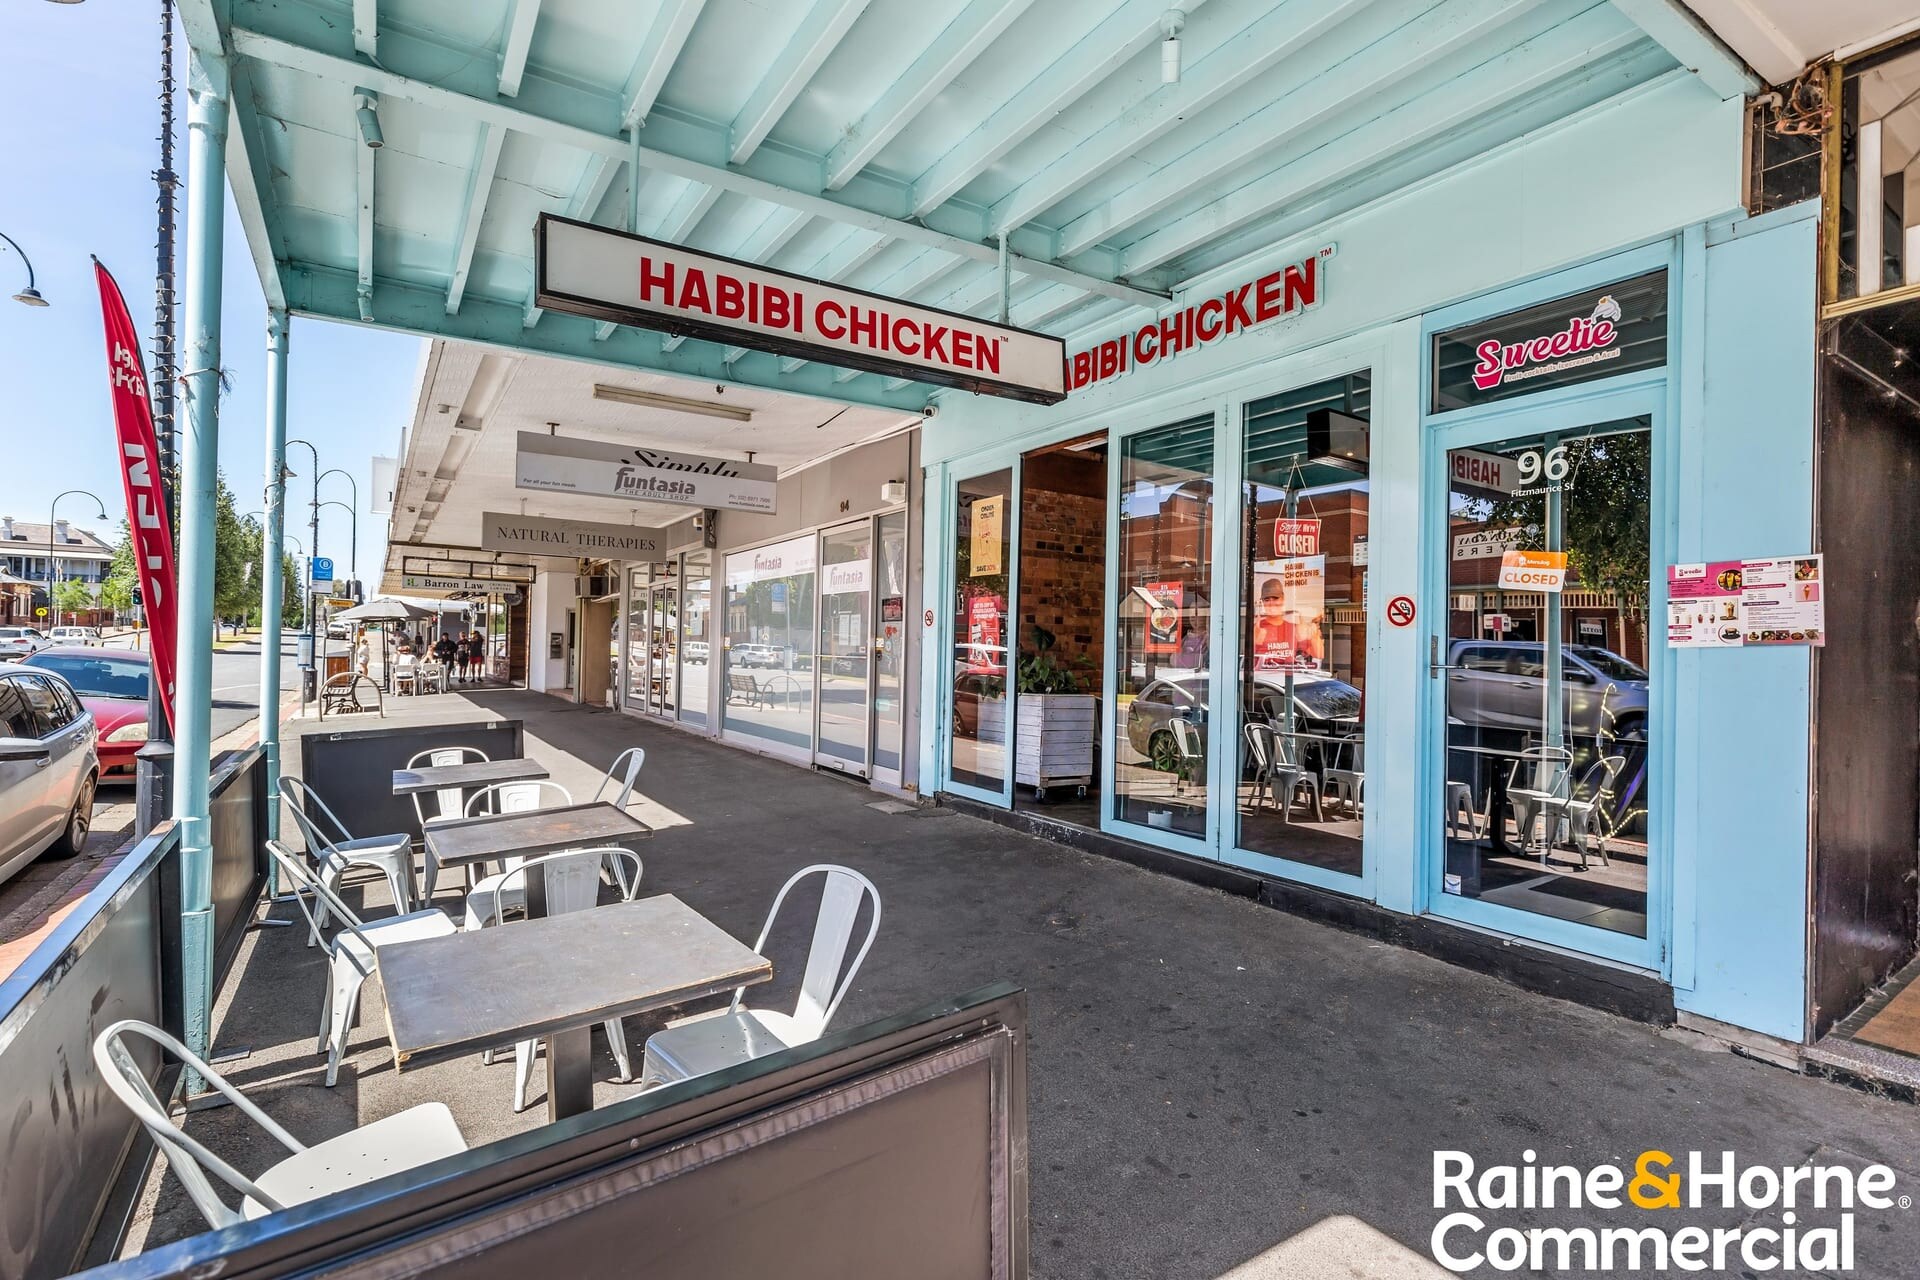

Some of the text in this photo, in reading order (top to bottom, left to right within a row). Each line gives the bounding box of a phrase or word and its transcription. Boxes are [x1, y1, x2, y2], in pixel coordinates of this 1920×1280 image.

[640, 256, 803, 333] HABIBI
[815, 300, 1001, 374] CHICKEN
[1065, 335, 1127, 392] BIBI
[1134, 256, 1316, 365] CHICKEN
[1477, 317, 1618, 376] Sweetie
[1517, 446, 1569, 485] 96
[643, 490, 666, 498] ADULT
[1511, 482, 1574, 498] Fitzmaurice St
[840, 500, 849, 512] 94
[1280, 522, 1302, 533] Sorry
[498, 527, 569, 545] NATURAL
[576, 533, 656, 551] THERAPIES
[1279, 534, 1315, 555] CLOSED
[1284, 562, 1305, 571] HAIBI
[1285, 570, 1312, 579] CHCKEN
[1504, 573, 1559, 585] CLOSED
[424, 579, 459, 588] Barron
[464, 581, 484, 590] Law
